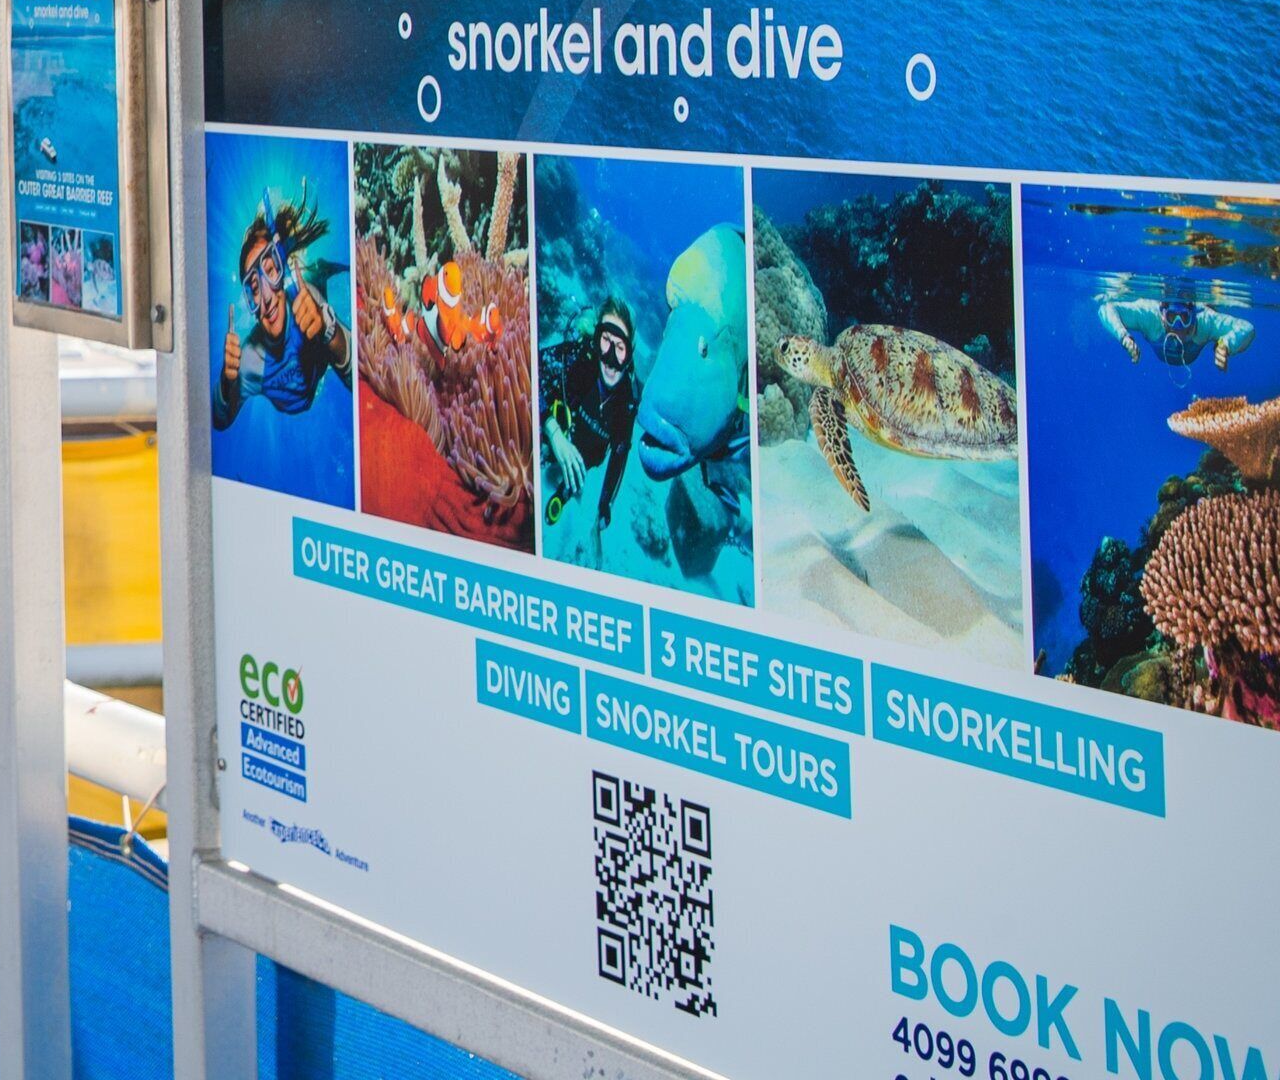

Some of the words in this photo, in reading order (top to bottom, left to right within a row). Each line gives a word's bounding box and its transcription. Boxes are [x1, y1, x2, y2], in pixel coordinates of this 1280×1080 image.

[34, 4, 58, 19] snorkel
[59, 4, 73, 19] and
[73, 4, 89, 20] dive
[448, 8, 602, 75] snorkel
[614, 8, 713, 78] and
[726, 7, 843, 81] dive
[18, 179, 41, 197] OUTER
[42, 183, 65, 200] GREAT
[66, 186, 96, 204] BARRIER
[97, 189, 114, 207] REEF
[300, 535, 370, 584] OUTER
[375, 556, 448, 604] GREAT
[454, 576, 558, 635] BARRIER
[566, 605, 633, 654] REEF
[239, 653, 304, 714] eco
[485, 658, 571, 716] DIVING
[660, 629, 676, 669] 3
[685, 636, 759, 688] REEF
[768, 657, 853, 715] SITES
[240, 698, 305, 740] CERTIFIED
[246, 727, 300, 765] Advanced
[596, 693, 727, 765] SNORKEL
[733, 731, 839, 798] TOURS
[886, 689, 1147, 793] SNORKELLING
[244, 756, 305, 799] Ecotourism
[889, 923, 1082, 1062] BOOK
[892, 1016, 977, 1078] 4099
[988, 1051, 1072, 1080] 69
